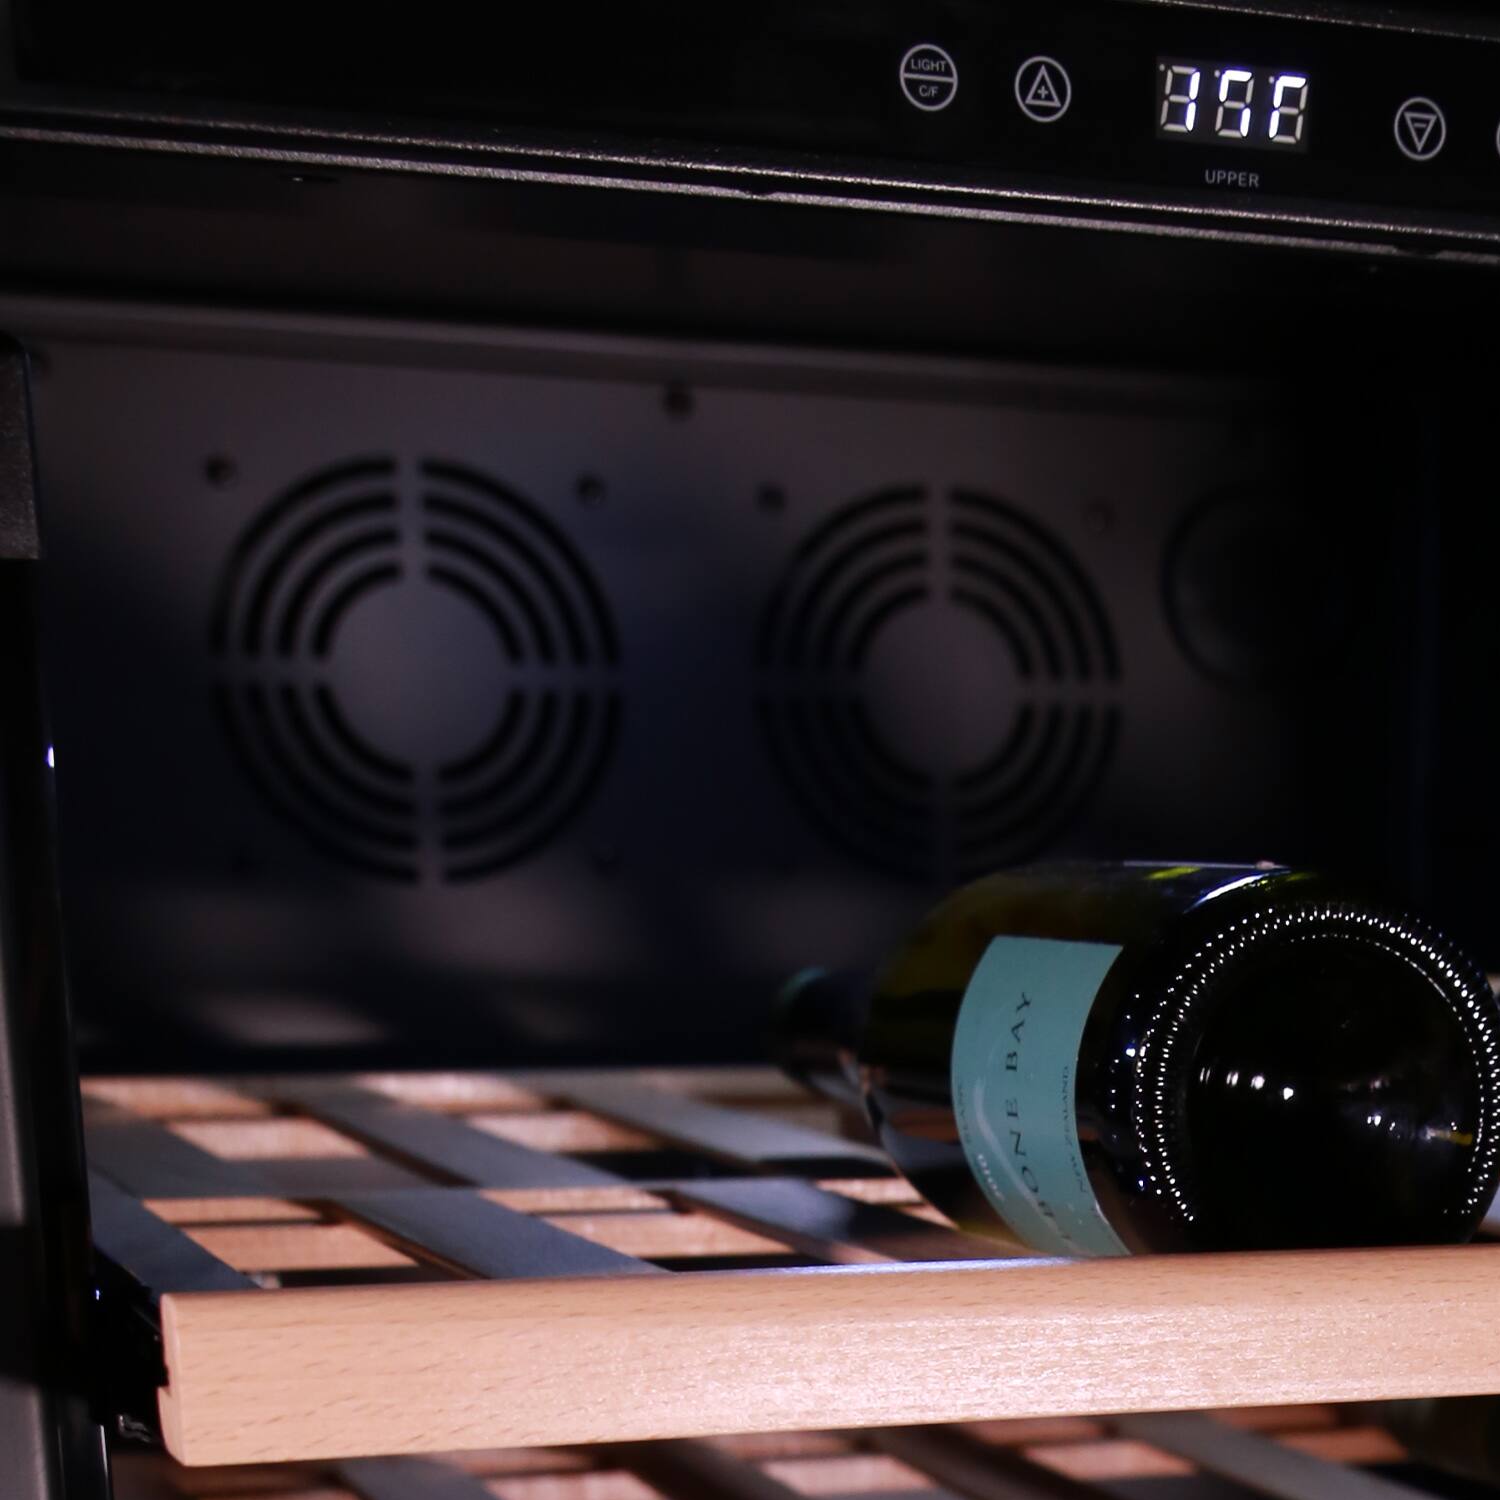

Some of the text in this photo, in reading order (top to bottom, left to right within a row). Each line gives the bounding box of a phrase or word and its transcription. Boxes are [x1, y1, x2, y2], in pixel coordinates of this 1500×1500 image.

[909, 56, 947, 74] LIGHT
[917, 84, 940, 99] C/F
[1204, 168, 1260, 190] UPPER
[1004, 991, 1032, 1072] BAY
